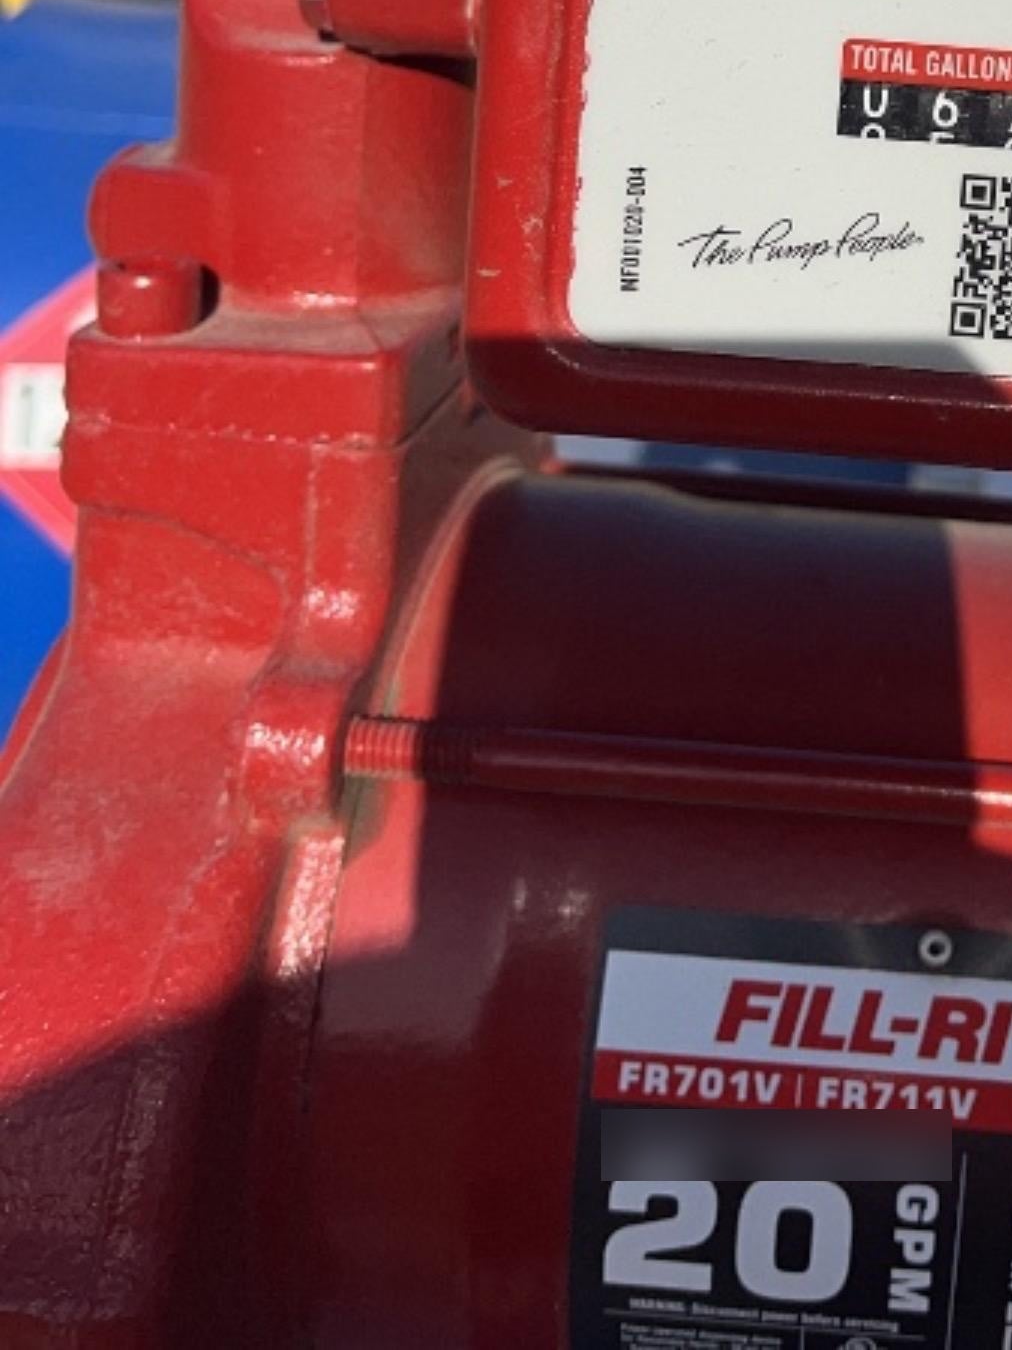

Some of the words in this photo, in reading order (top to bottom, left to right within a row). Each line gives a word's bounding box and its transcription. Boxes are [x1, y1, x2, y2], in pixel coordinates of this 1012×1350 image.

[851, 44, 917, 76] TOTAL
[677, 223, 744, 268] The
[748, 217, 833, 271] Pump
[618, 1060, 782, 1105] FR701V
[816, 1077, 978, 1120] FR711V
[602, 1180, 853, 1304] 20
[886, 1183, 940, 1314] GPM
